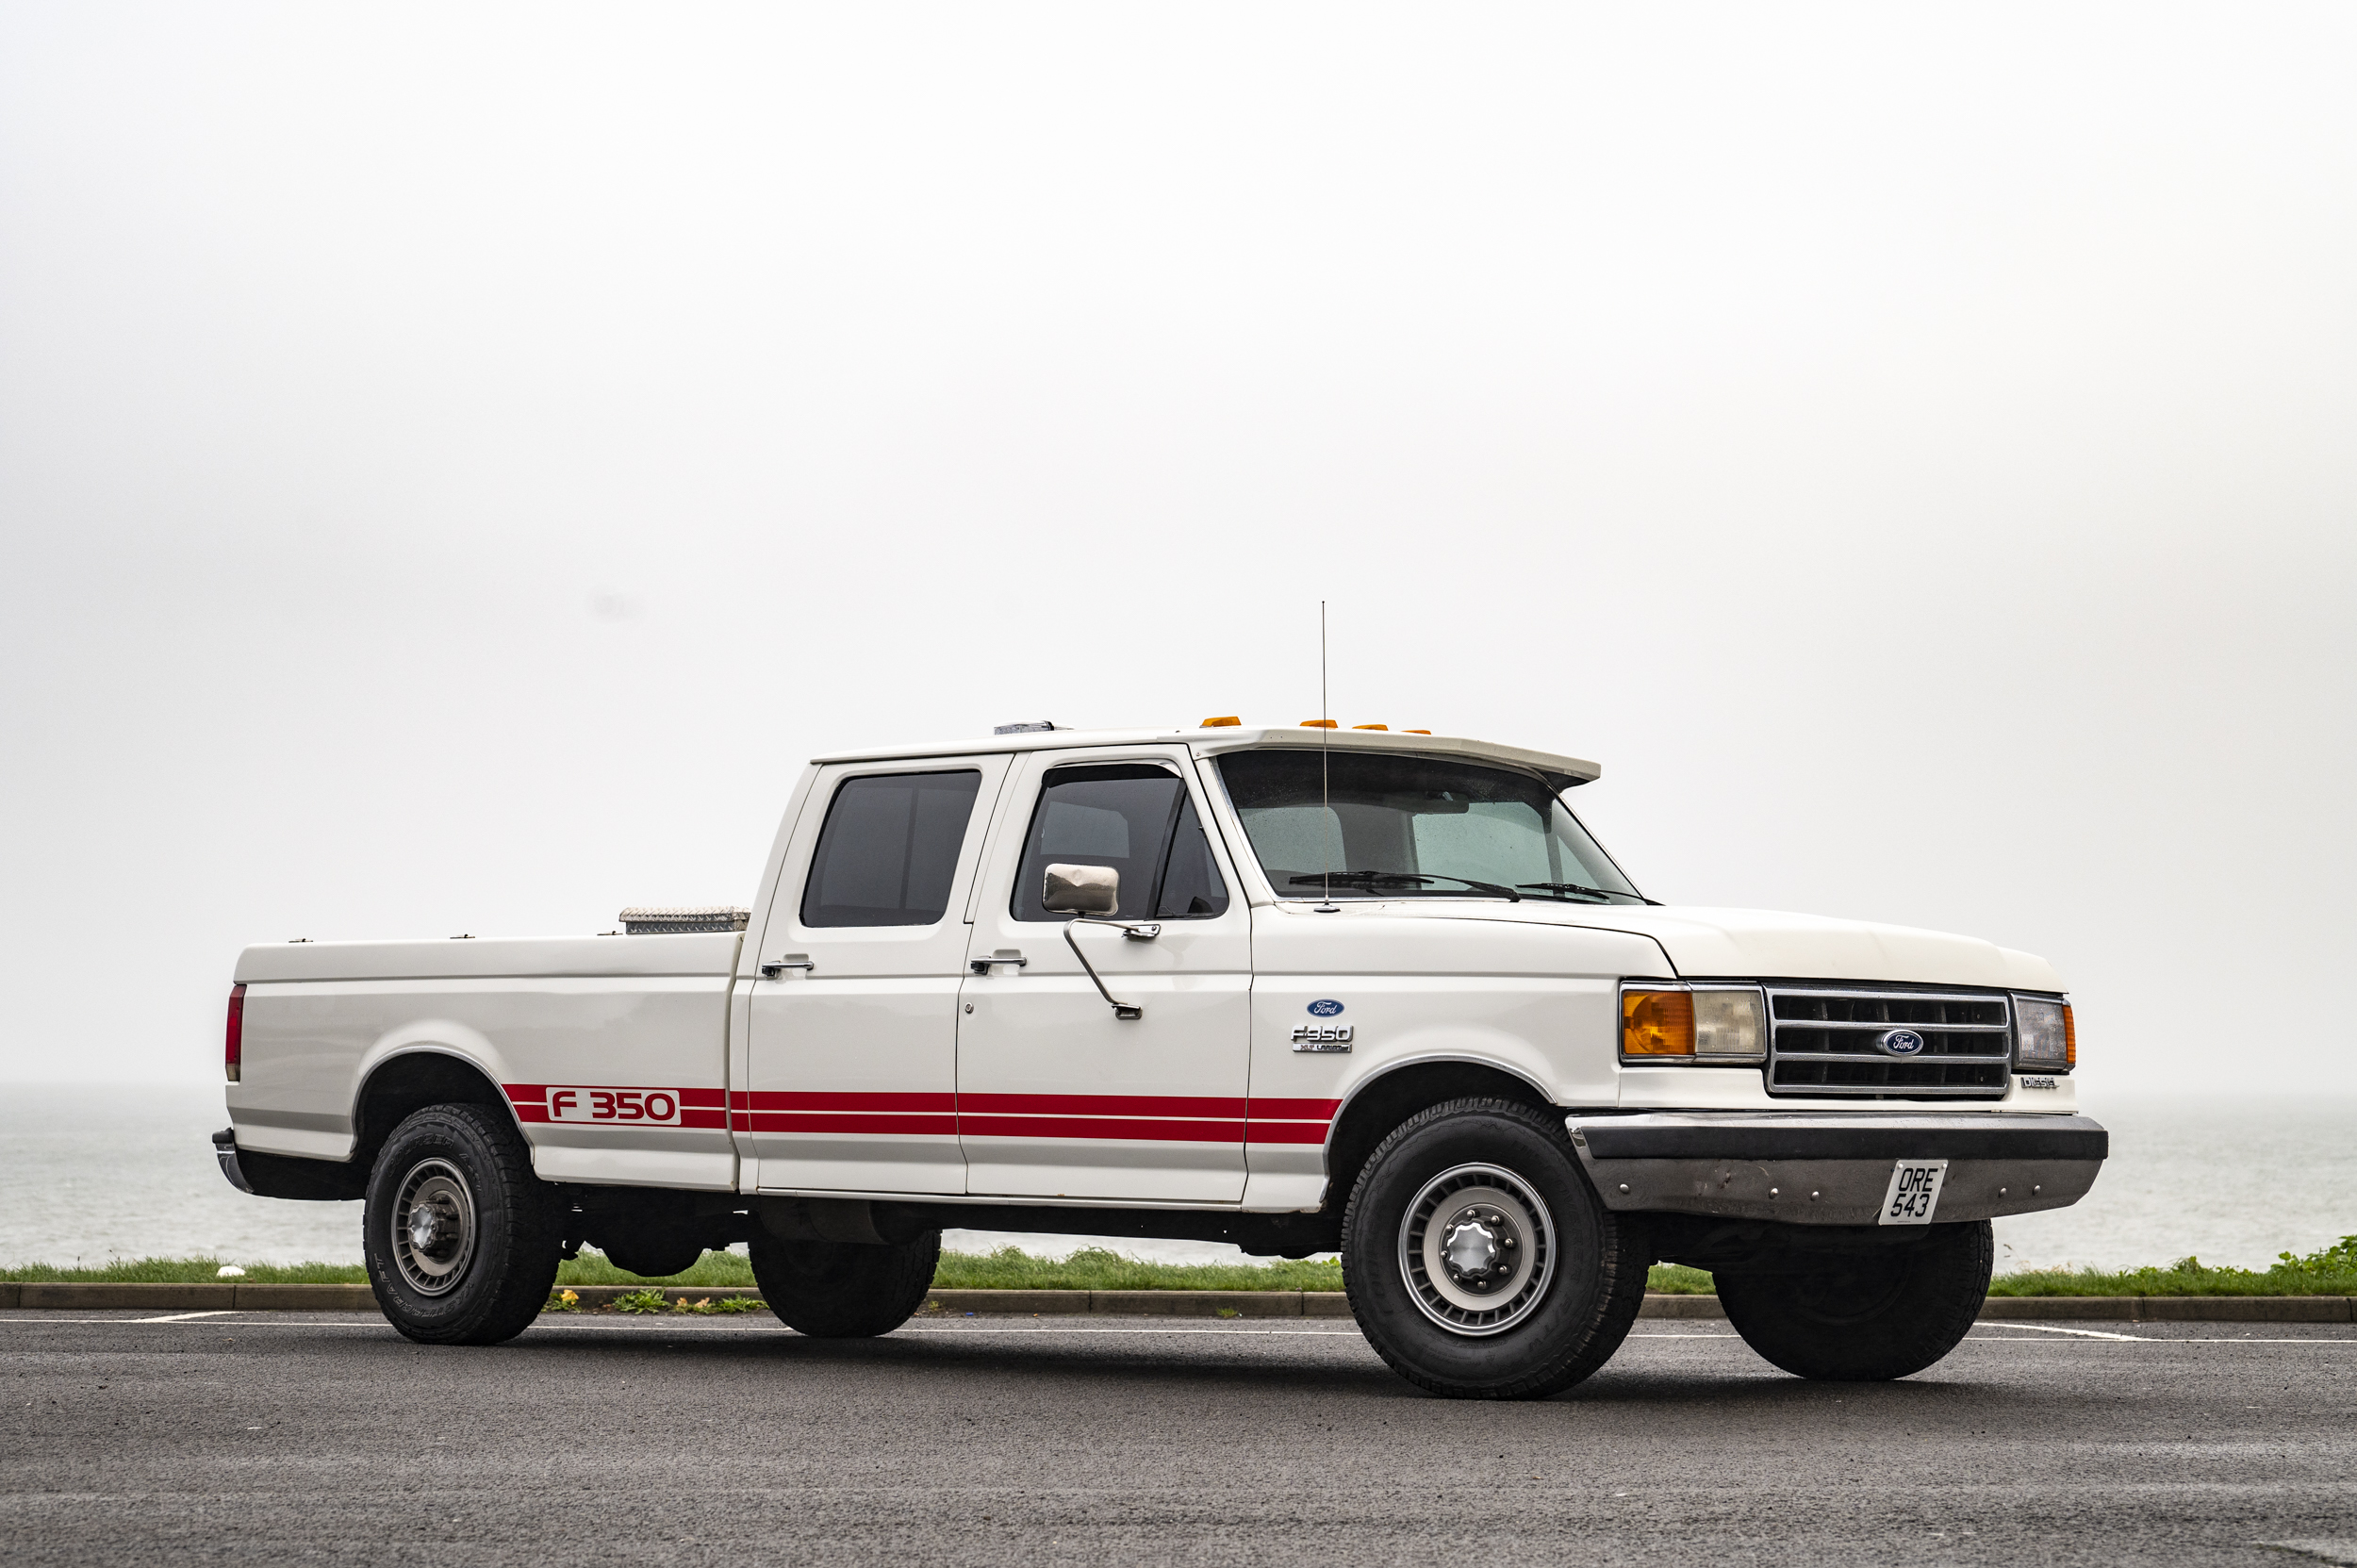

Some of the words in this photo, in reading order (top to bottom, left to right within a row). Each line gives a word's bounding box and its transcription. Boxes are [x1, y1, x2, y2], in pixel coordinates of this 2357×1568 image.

[1313, 1001, 1337, 1015] Ford
[1892, 1034, 1914, 1050] Ford
[2020, 1077, 2060, 1089] DIESEL
[552, 1091, 577, 1117] F
[589, 1092, 675, 1120] 350
[387, 1132, 454, 1178] COURSER
[1898, 1167, 1938, 1193] ORE
[1890, 1194, 1930, 1217] 543
[373, 1253, 474, 1318] MASTERCRAFT
